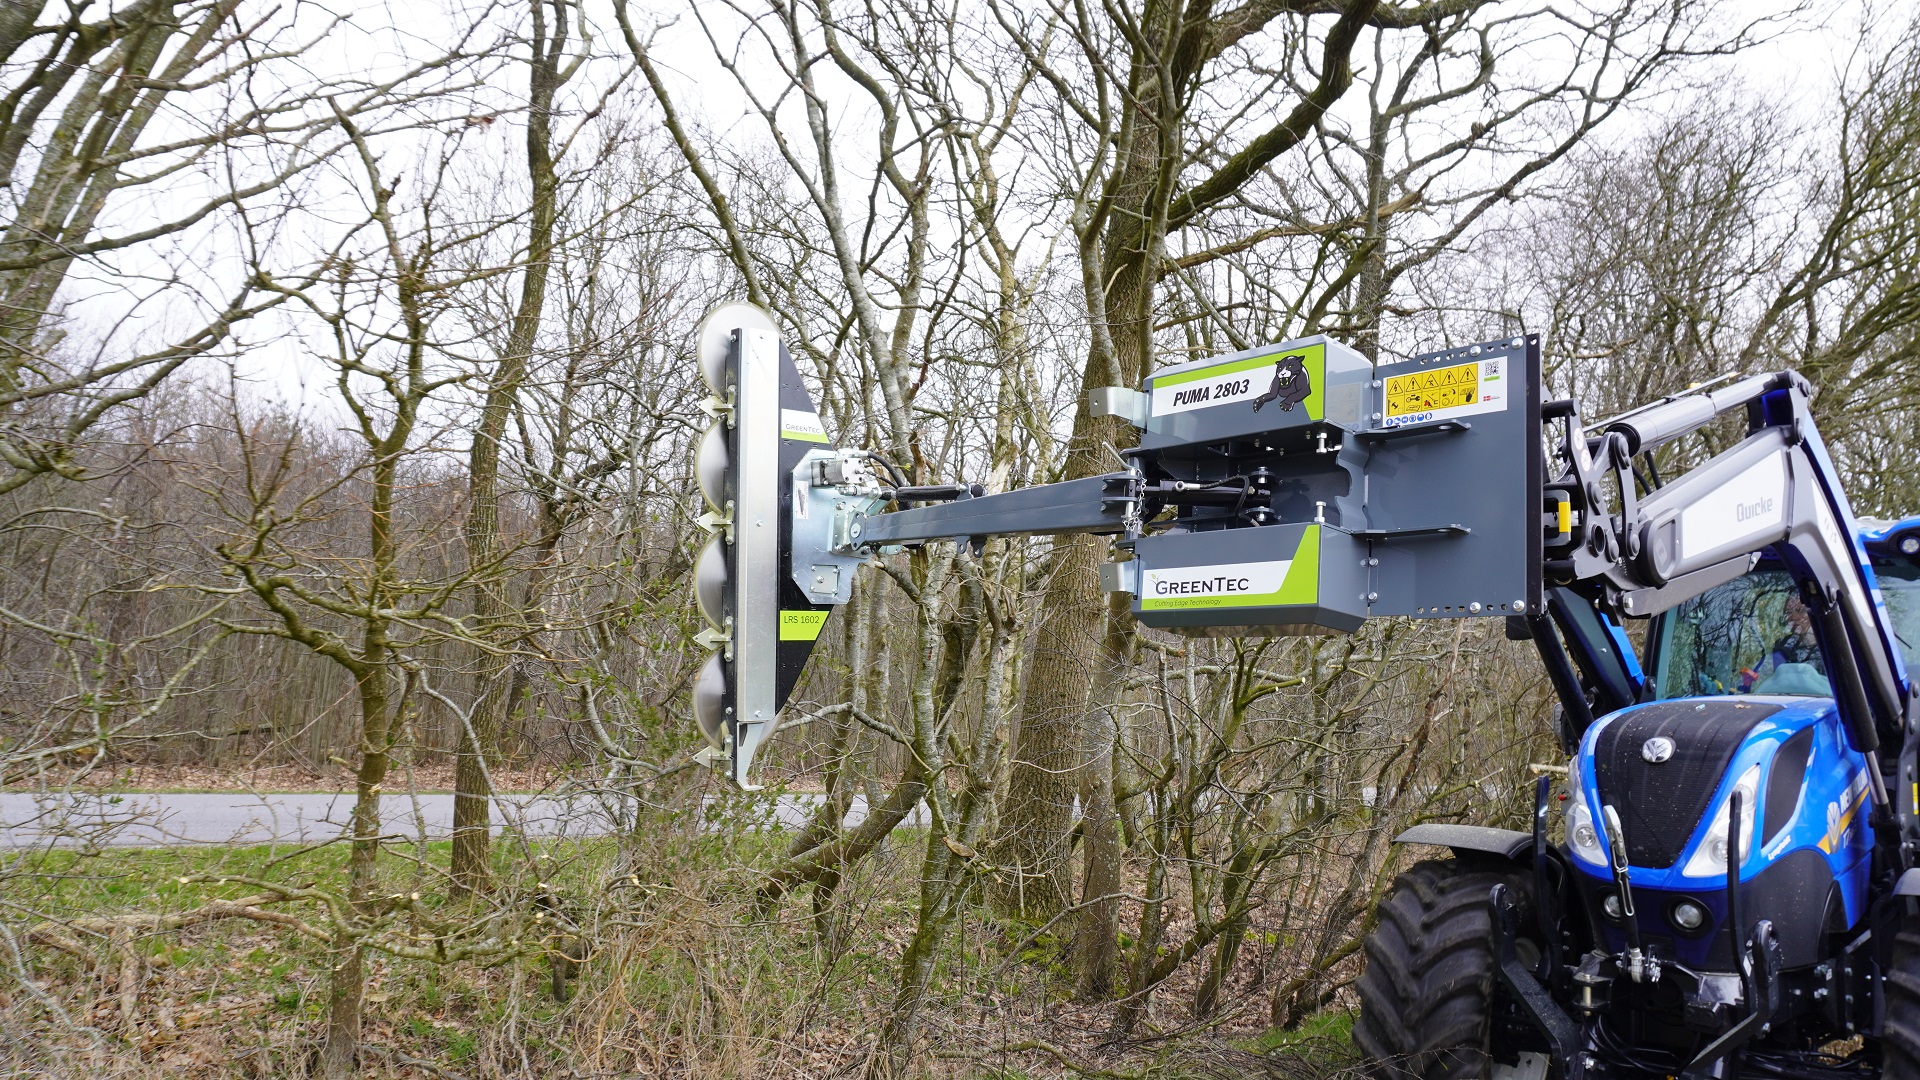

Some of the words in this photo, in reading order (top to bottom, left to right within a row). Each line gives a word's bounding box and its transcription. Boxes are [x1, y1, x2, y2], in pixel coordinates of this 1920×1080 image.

[1173, 386, 1210, 407] PUMA
[1213, 379, 1250, 399] 2803
[1736, 496, 1773, 523] Quicke
[1155, 577, 1249, 595] GREENTEC
[1154, 600, 1174, 608] Cutting
[1174, 600, 1188, 608] Edge
[1189, 598, 1221, 607] Technology
[783, 615, 799, 624] LRS
[800, 615, 820, 624] 1602
